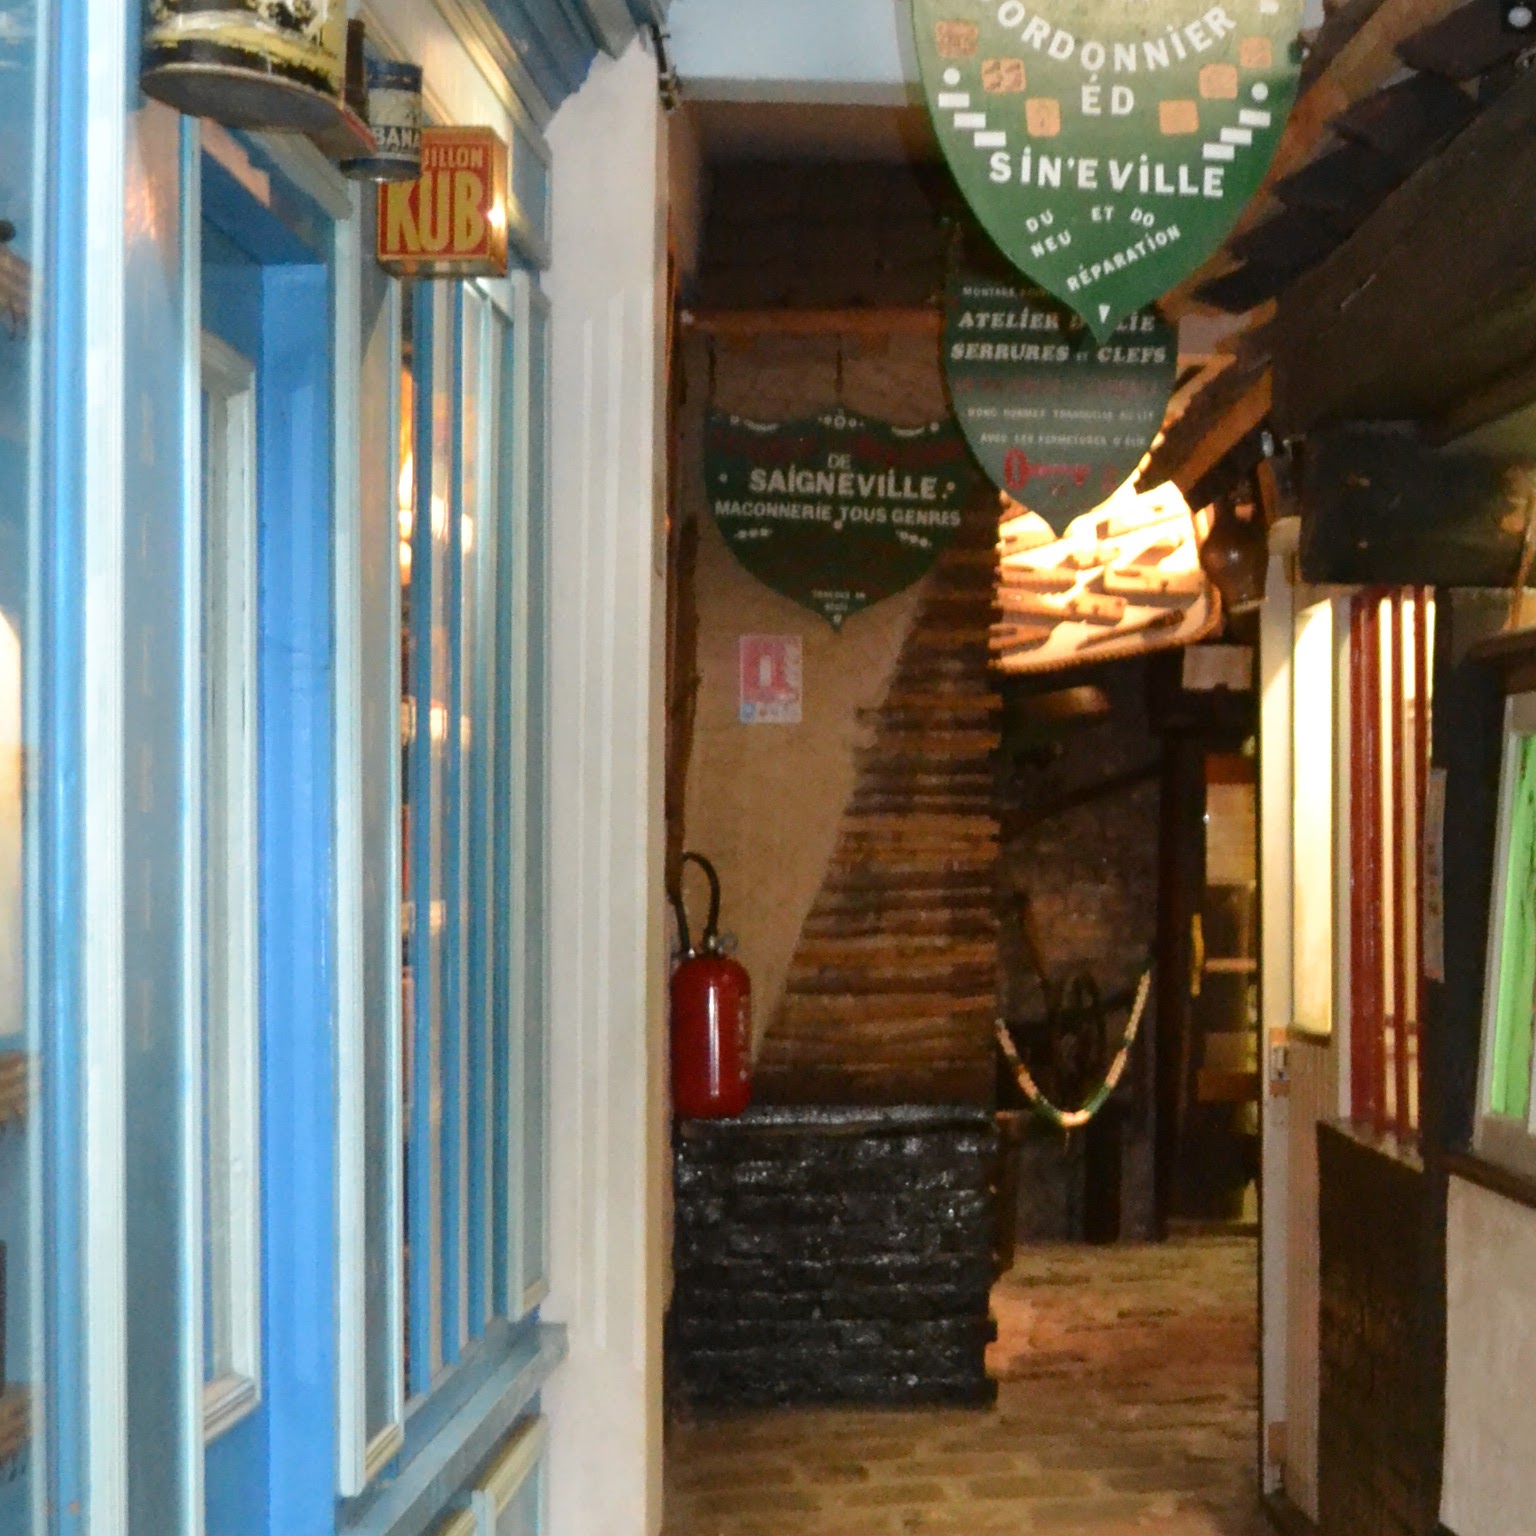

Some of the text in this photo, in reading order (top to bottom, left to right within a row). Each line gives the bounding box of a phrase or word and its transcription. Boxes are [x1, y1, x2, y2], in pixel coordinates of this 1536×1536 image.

[1081, 74, 1135, 116] ÉD
[386, 170, 485, 253] KUB
[1025, 208, 1053, 233] DU
[1091, 206, 1156, 228] ET DO
[1031, 230, 1072, 258] NEU
[1066, 224, 1181, 293] RÉPARATION
[958, 307, 1060, 331] ATELIER
[951, 342, 1070, 362] SERRURES
[1097, 347, 1166, 364] CLEFS
[827, 453, 851, 470] DE
[748, 464, 937, 500] SAIGNEVILLE
[835, 505, 887, 523] TOUS
[891, 507, 961, 528] GENRES
